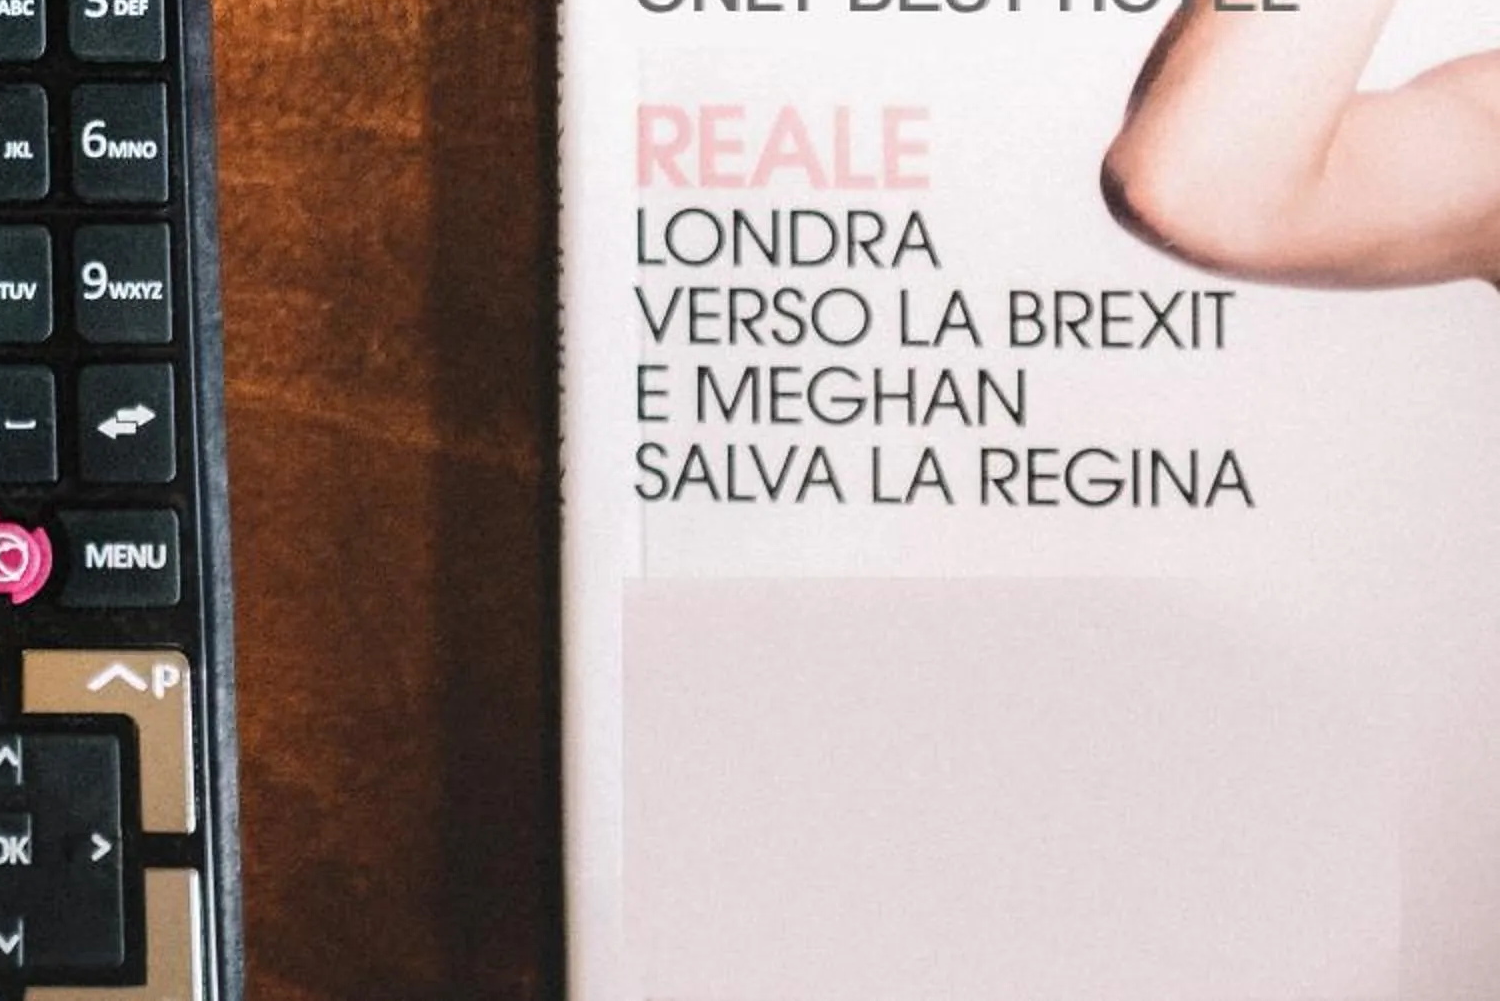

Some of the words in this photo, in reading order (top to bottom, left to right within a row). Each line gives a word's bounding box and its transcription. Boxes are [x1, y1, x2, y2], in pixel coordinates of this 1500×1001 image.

[636, 103, 931, 190] REALE
[636, 207, 942, 269] LONDRA
[633, 285, 873, 348] VERSO
[899, 288, 983, 348] LA
[1008, 289, 1236, 350] BREXIT
[636, 363, 669, 423] E
[696, 364, 1026, 428] MEGHAN
[633, 441, 845, 504] SALVA
[871, 445, 955, 506] LA
[979, 446, 1255, 509] REGINA
[85, 542, 167, 570] MENU
